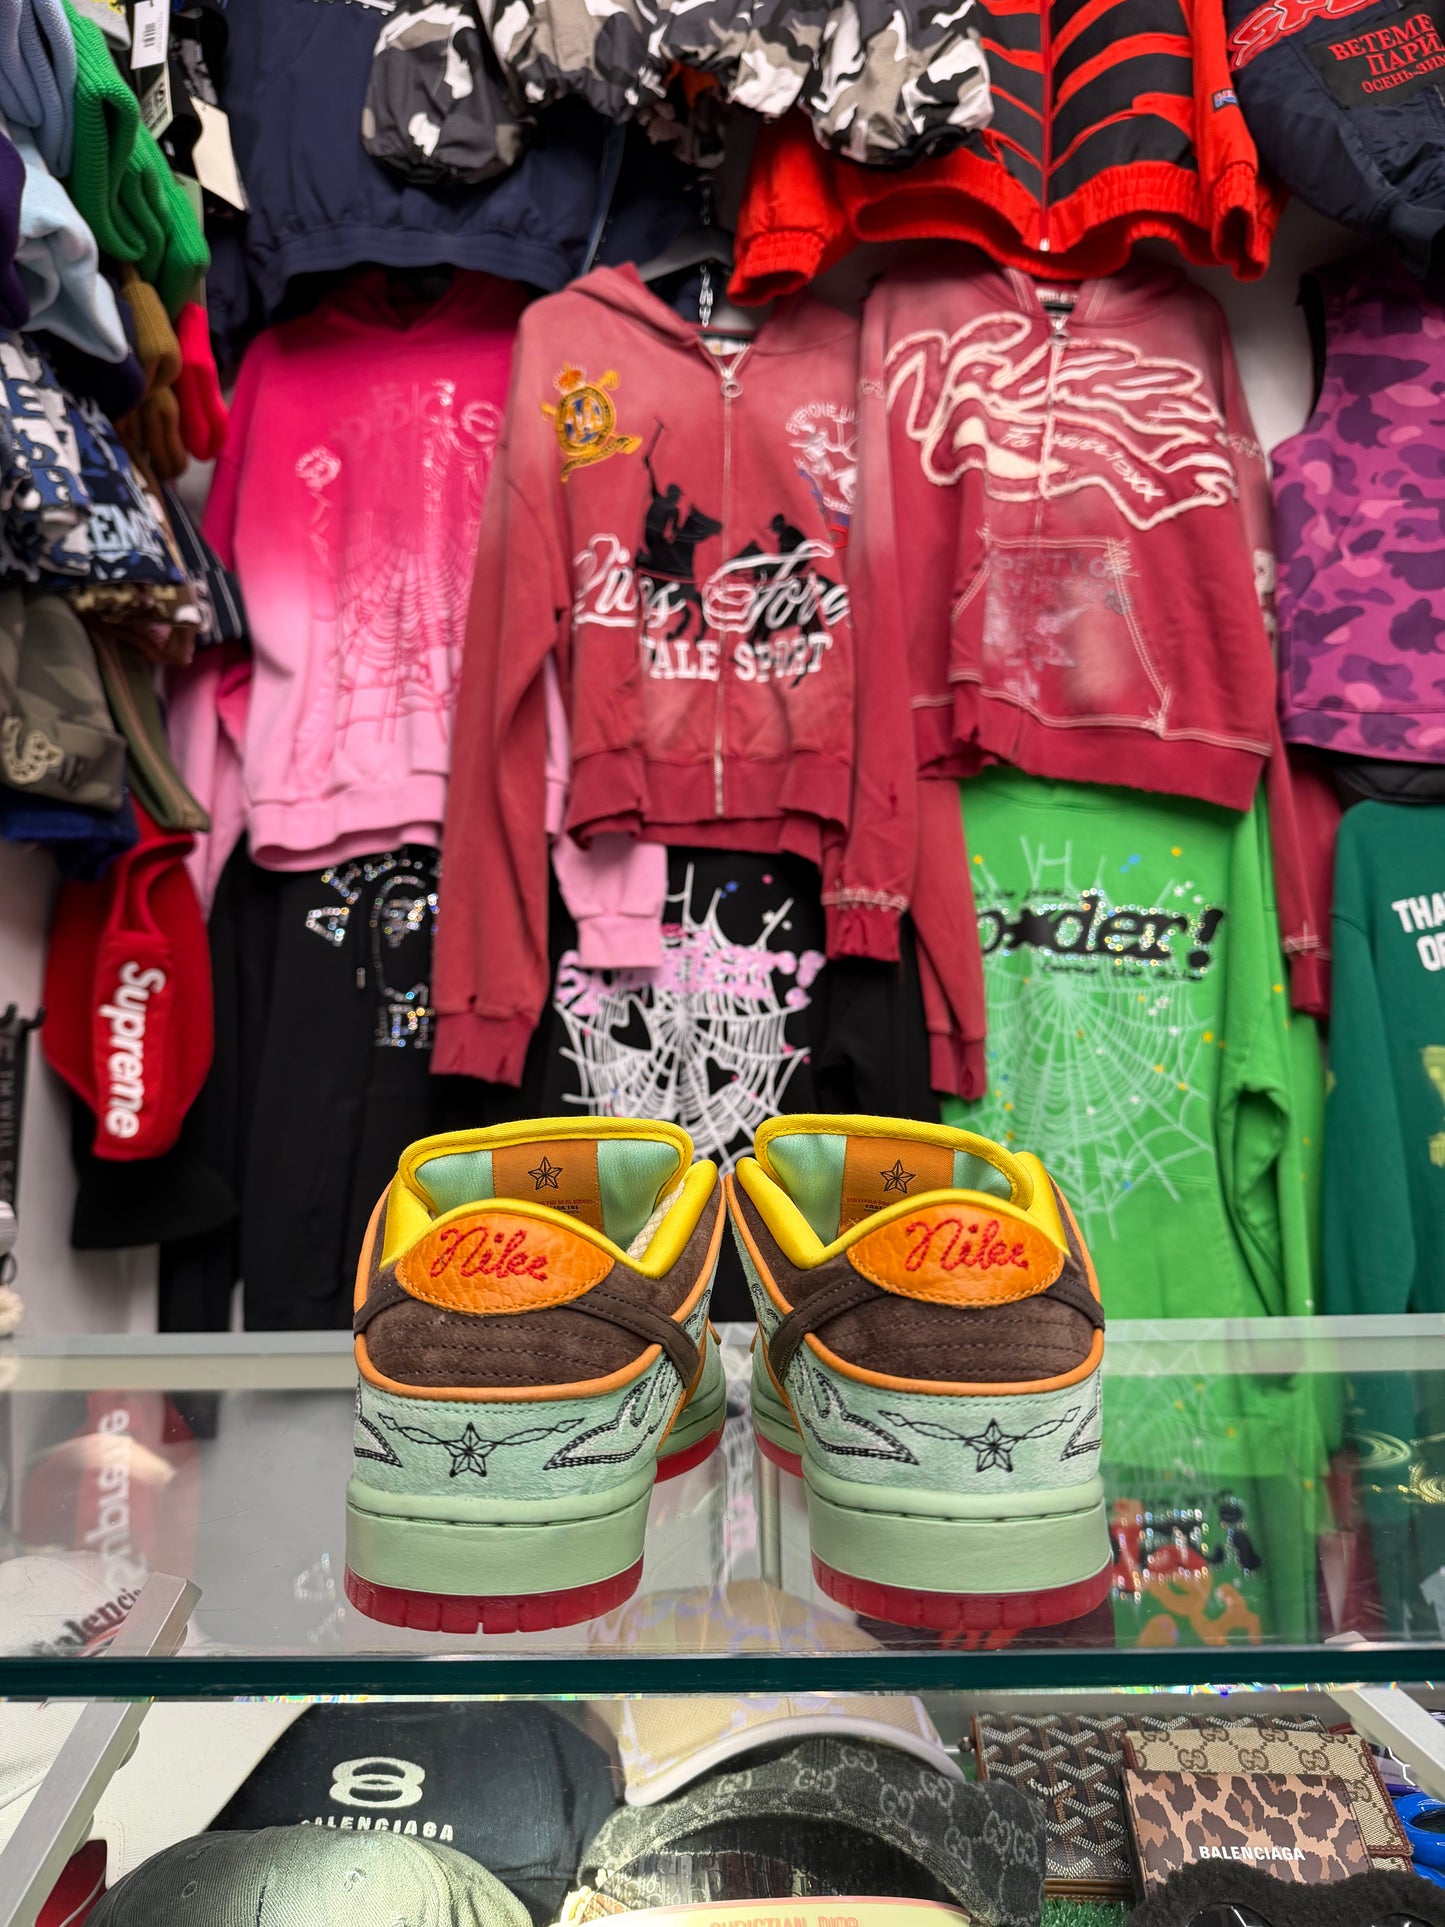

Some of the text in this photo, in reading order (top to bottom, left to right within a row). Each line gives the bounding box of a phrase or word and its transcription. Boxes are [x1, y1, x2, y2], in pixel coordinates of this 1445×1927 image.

[1366, 33, 1445, 75] ПАРИ
[1391, 890, 1445, 933] THA
[98, 960, 166, 1139] Supreme
[430, 1226, 548, 1282] Nike
[905, 1218, 1029, 1271] Nike
[1199, 1844, 1306, 1862] BALENCIAGA
